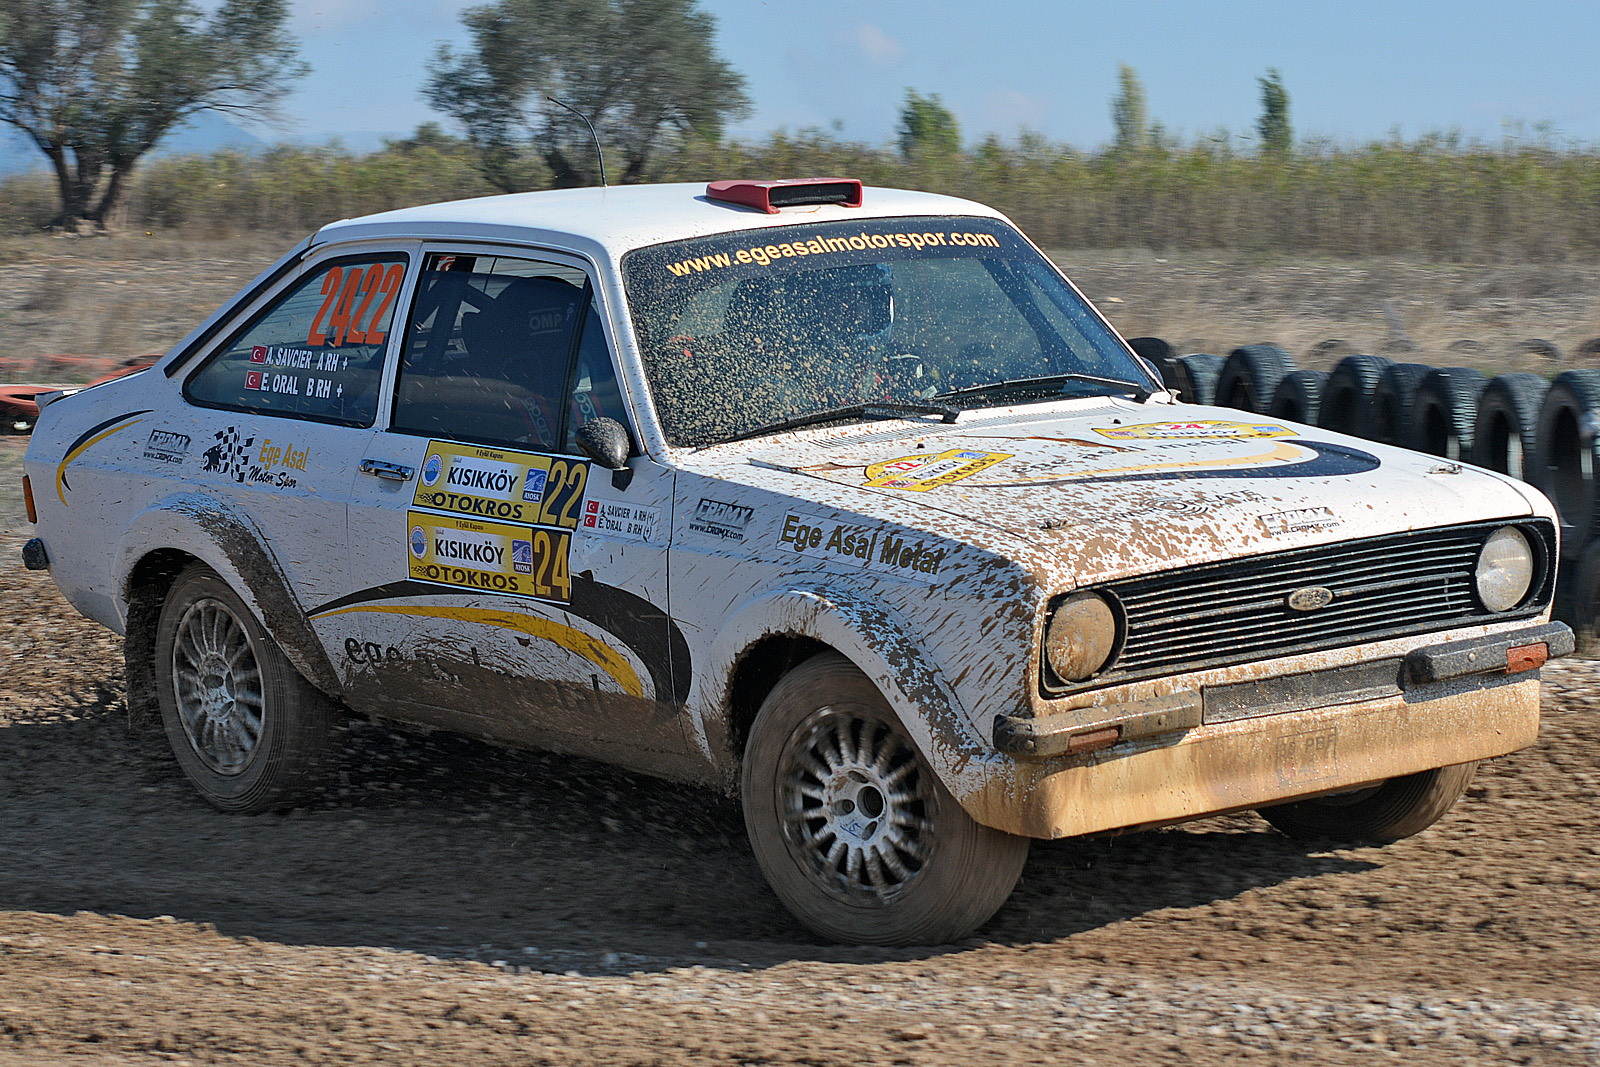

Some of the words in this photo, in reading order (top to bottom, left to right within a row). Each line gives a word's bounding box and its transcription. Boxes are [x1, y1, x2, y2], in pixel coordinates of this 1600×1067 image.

[666, 232, 1001, 277] www.egeasalmotorspor.com
[306, 262, 404, 346] 2422
[528, 312, 562, 331] OMP
[265, 346, 274, 365] A.
[316, 353, 324, 371] A
[324, 354, 340, 372] RH
[260, 372, 270, 392] E.
[272, 373, 299, 396] ORAL
[306, 377, 315, 397] B
[315, 378, 332, 399] RH
[259, 438, 280, 471] Ege
[281, 442, 311, 470] Asal
[249, 465, 275, 484] Motor
[275, 471, 298, 490] Spor
[447, 466, 518, 493] KISIKKÖY
[433, 492, 524, 519] OTOKROS
[539, 460, 587, 529] 22
[605, 519, 622, 532] ORAL
[435, 538, 505, 565] KISIKKÖY
[780, 514, 822, 553] Ege
[825, 524, 878, 562] Asal
[879, 534, 946, 575] Metal
[427, 564, 519, 591] OTOKROS
[534, 530, 571, 600] 24
